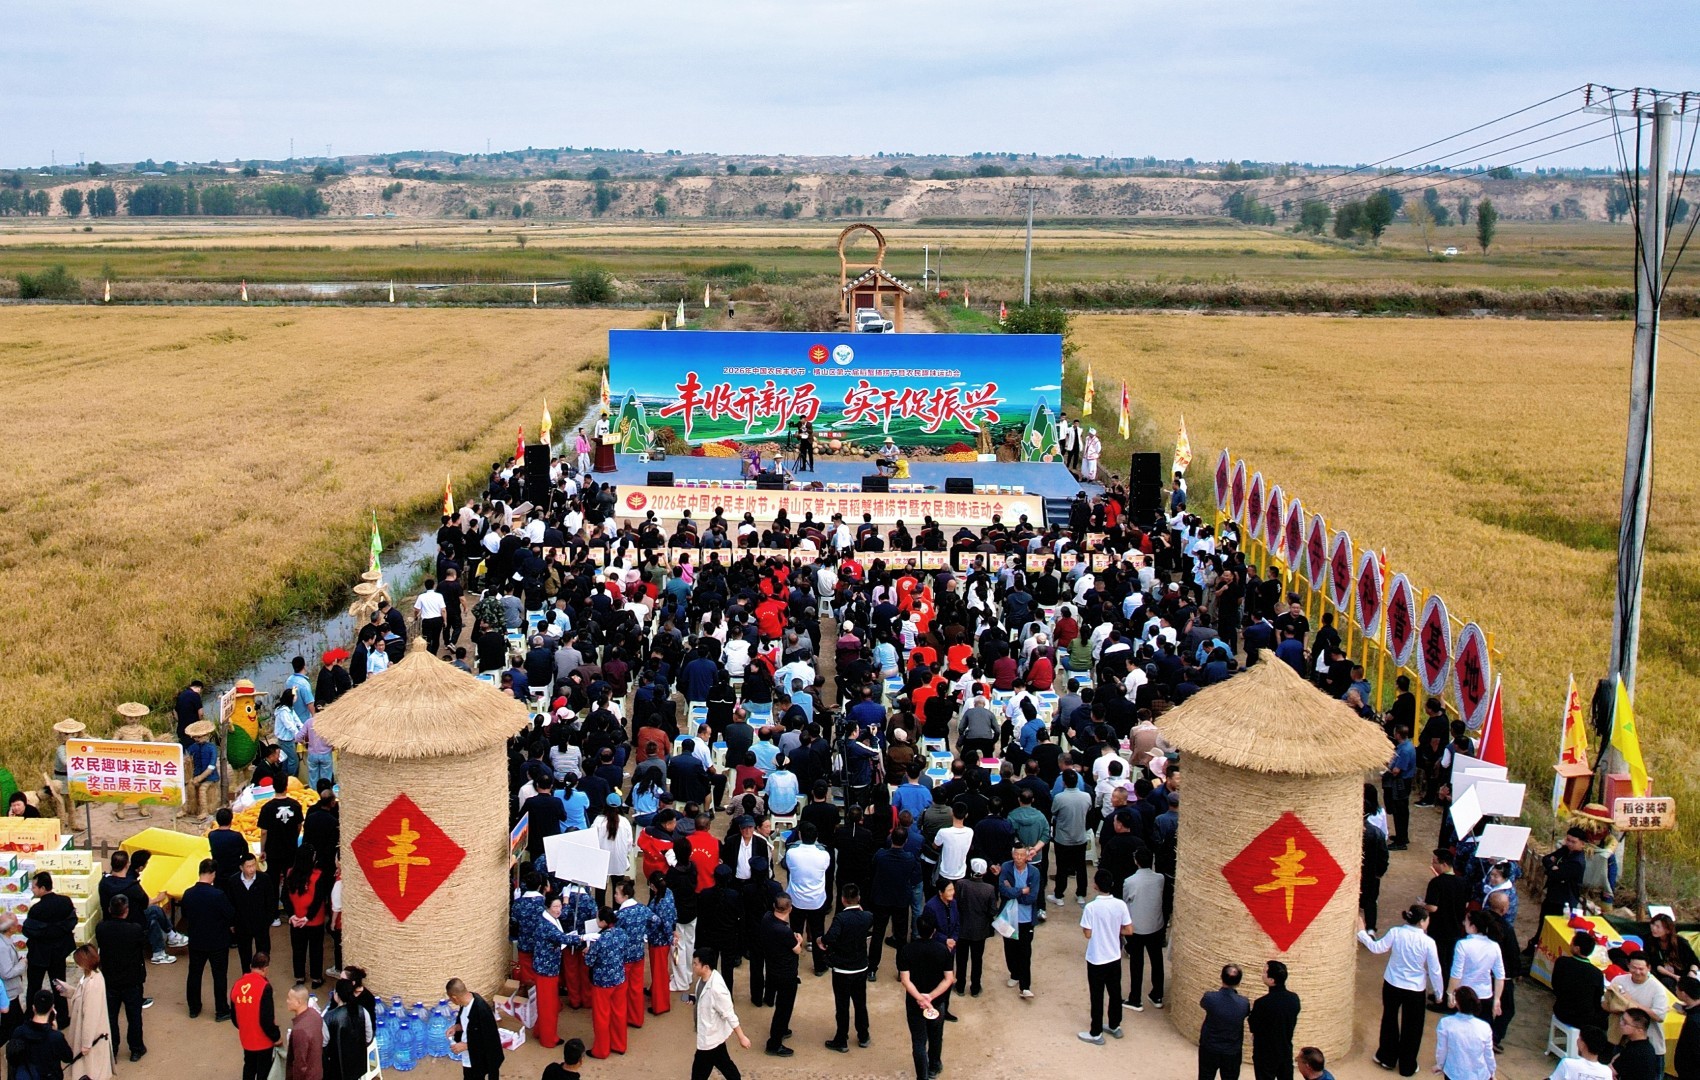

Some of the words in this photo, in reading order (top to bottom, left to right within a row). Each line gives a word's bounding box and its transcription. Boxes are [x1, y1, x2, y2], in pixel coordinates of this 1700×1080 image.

[659, 371, 821, 440] 丰收开新局
[833, 379, 1004, 434] 实干促振兴
[71, 756, 177, 776] 农民趣味运动会
[87, 776, 162, 793] 奖品展示区
[1623, 802, 1667, 814] 稻谷装袋
[1628, 816, 1661, 827] 竞速赛
[373, 817, 431, 898] 丰
[1253, 836, 1319, 924] 丰
